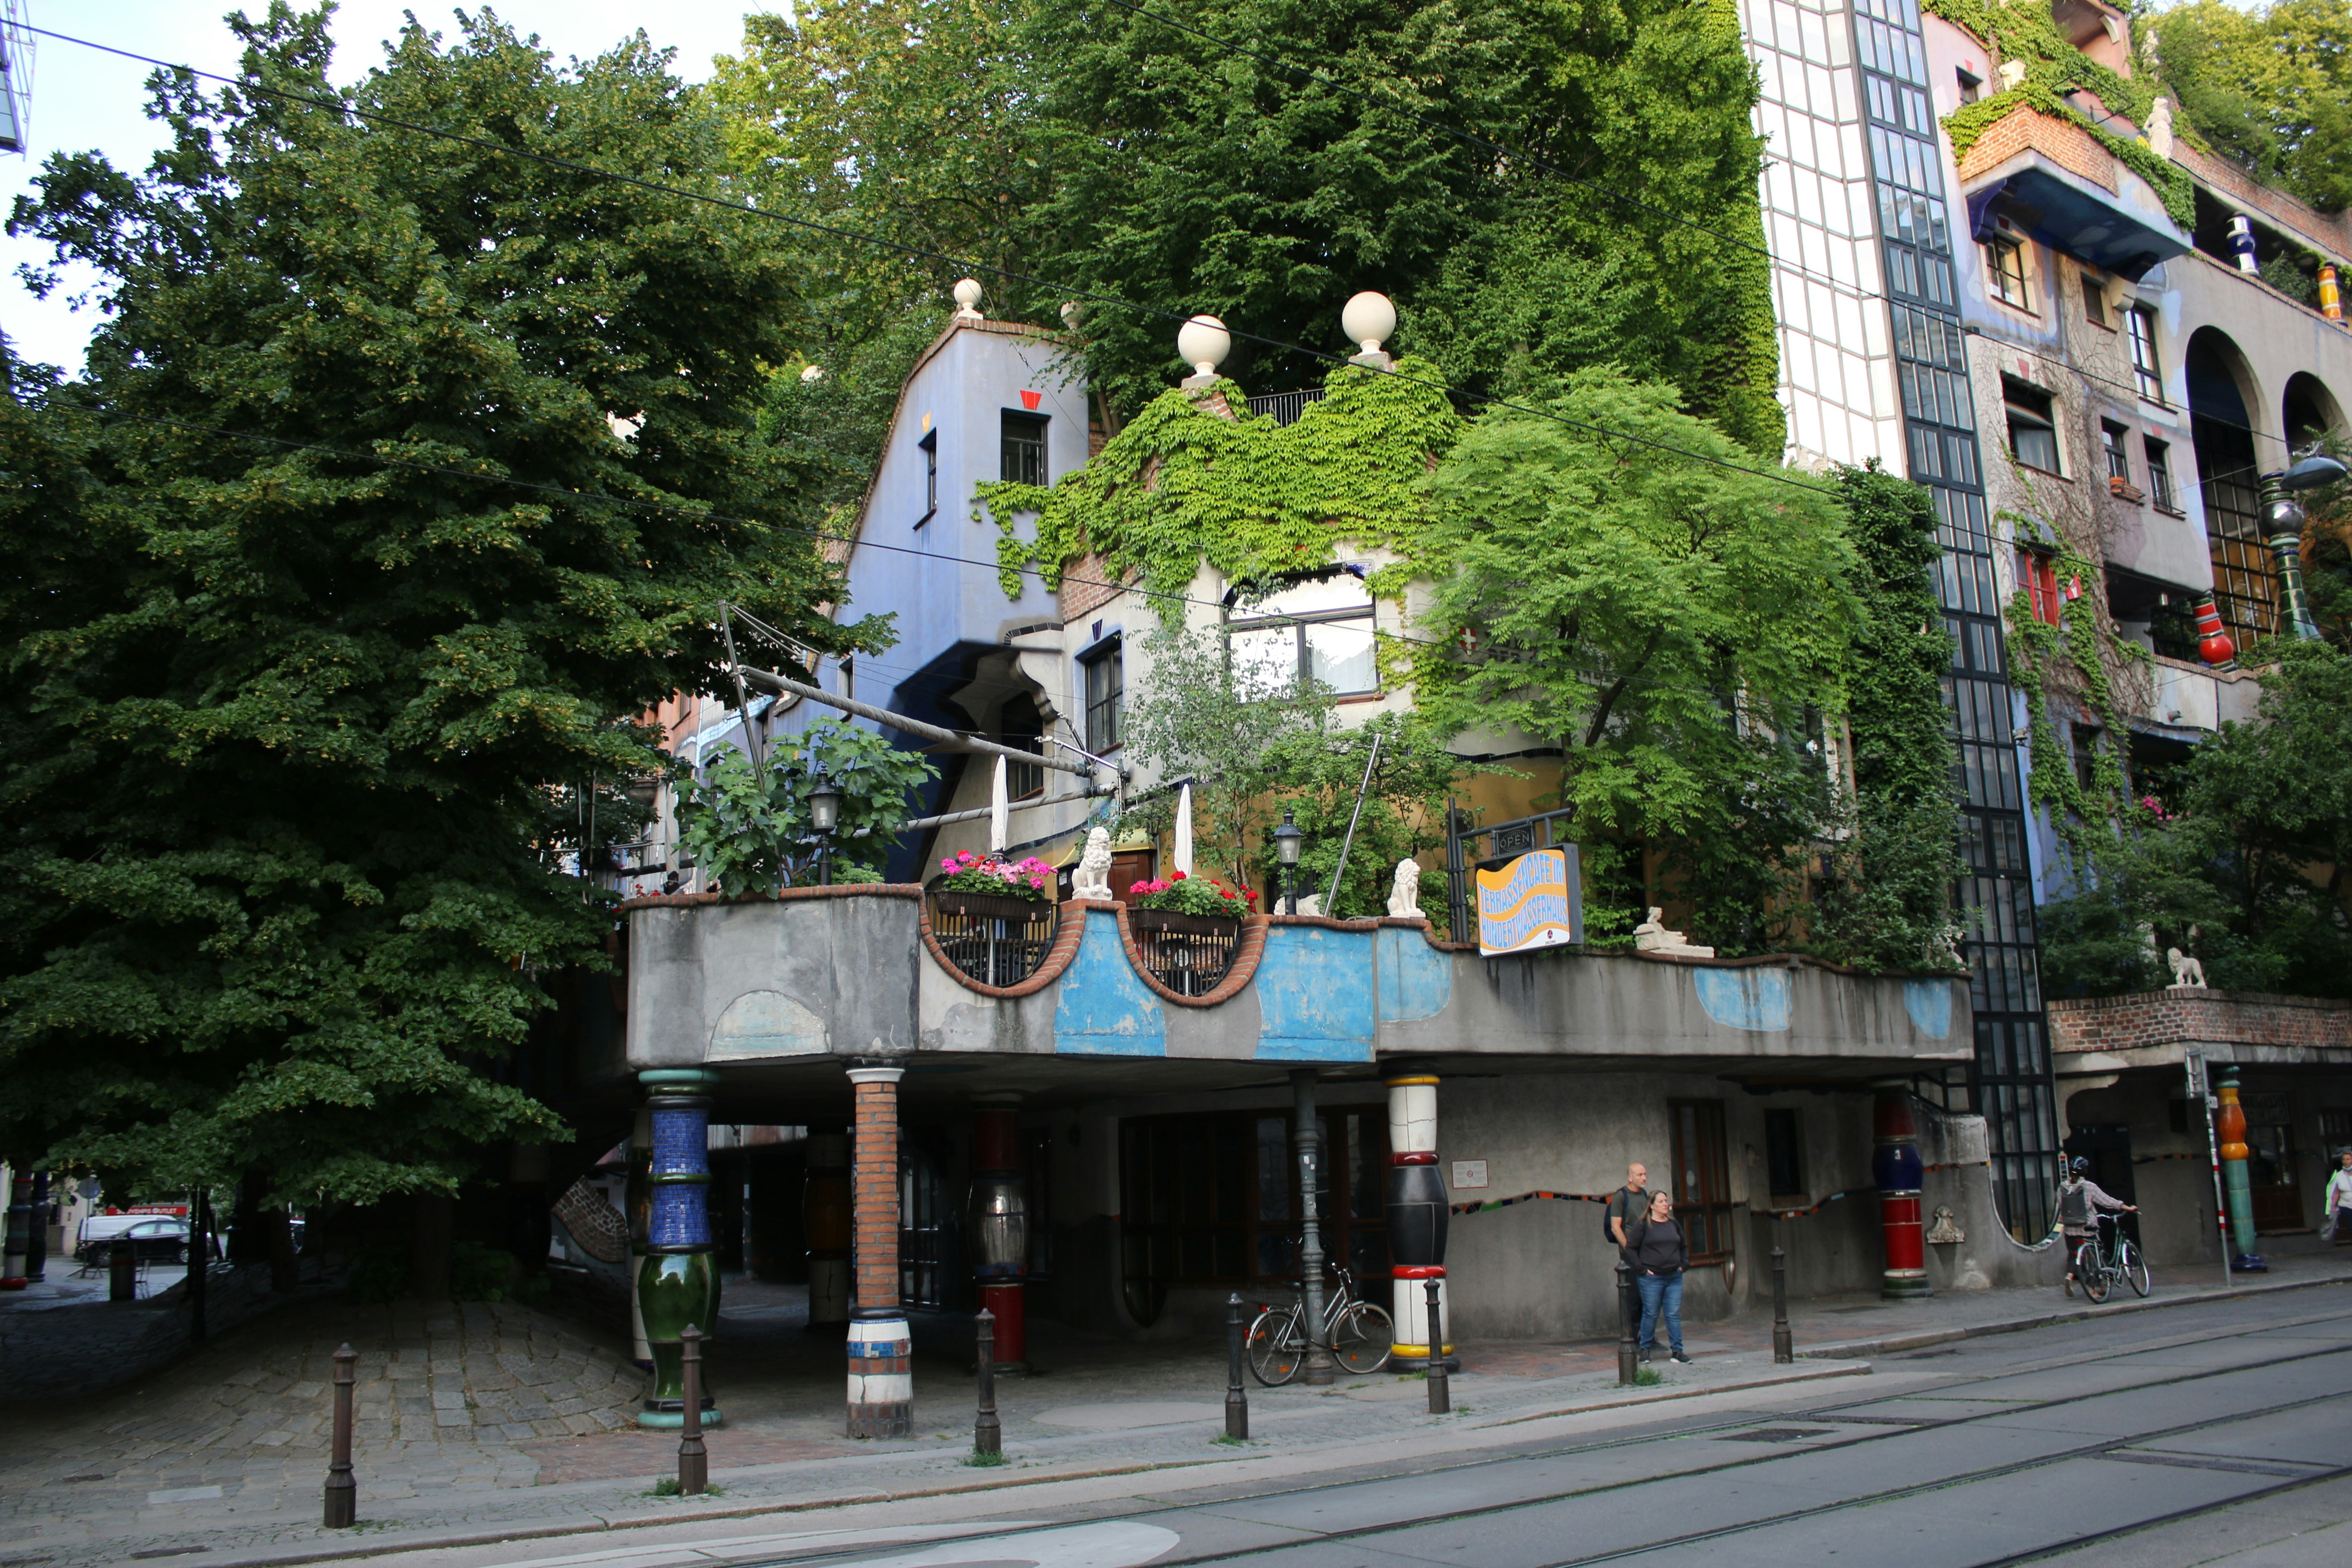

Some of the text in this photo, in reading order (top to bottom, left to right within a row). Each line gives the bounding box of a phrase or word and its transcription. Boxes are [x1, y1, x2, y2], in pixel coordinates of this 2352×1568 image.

[1500, 833, 1529, 848] OPEN
[1478, 853, 1565, 914] TERRASSENCAFE IM
[1480, 894, 1568, 948] HUNDERTWASSERHAUS
